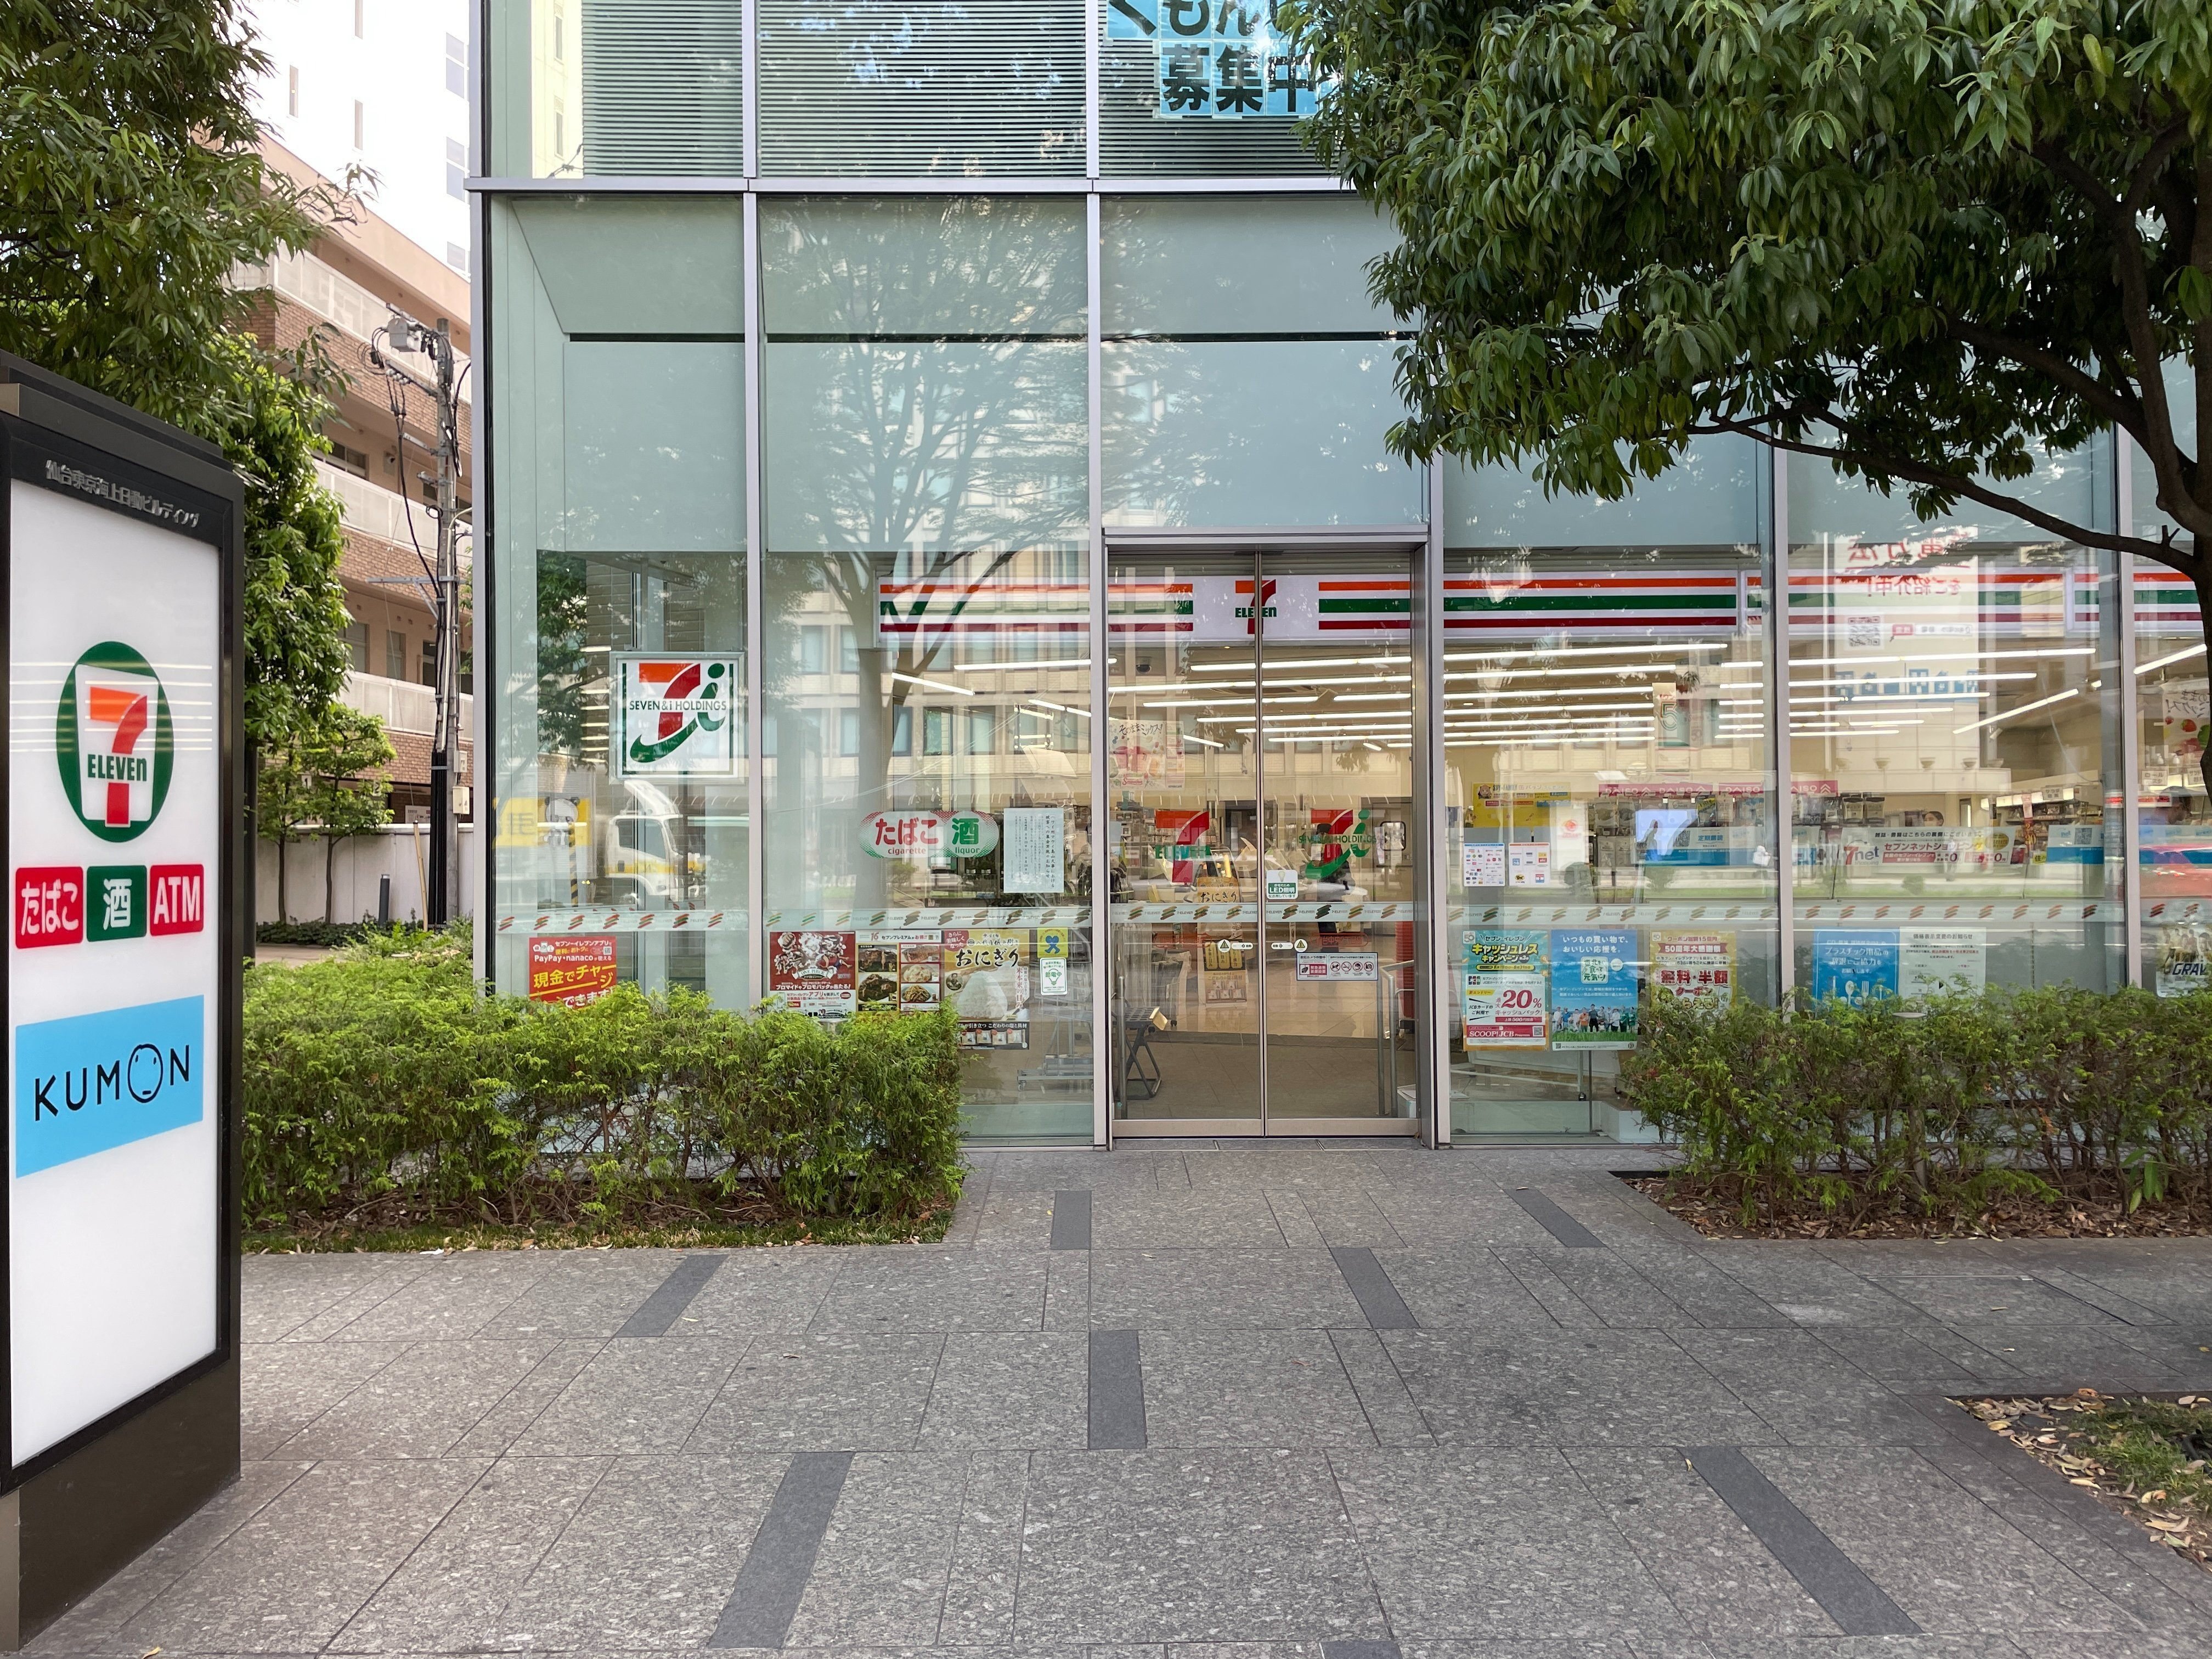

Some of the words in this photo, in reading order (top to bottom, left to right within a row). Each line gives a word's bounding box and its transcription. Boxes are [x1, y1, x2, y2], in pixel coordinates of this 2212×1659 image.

[1163, 43, 1316, 112] 募集中
[675, 701, 727, 711] HOLDINGS
[876, 817, 939, 845] たばこ
[952, 818, 979, 845] 酒
[888, 847, 927, 855] cigarette
[955, 847, 980, 855] liquor
[21, 879, 78, 936] たばこ
[103, 878, 132, 930] 酒
[154, 876, 200, 924] ATM
[1472, 944, 1538, 955] キャッシュレス
[1563, 935, 1629, 944] いつもの買い物で、
[956, 948, 1019, 968] おにぎり
[35, 1043, 189, 1121] KUMON
